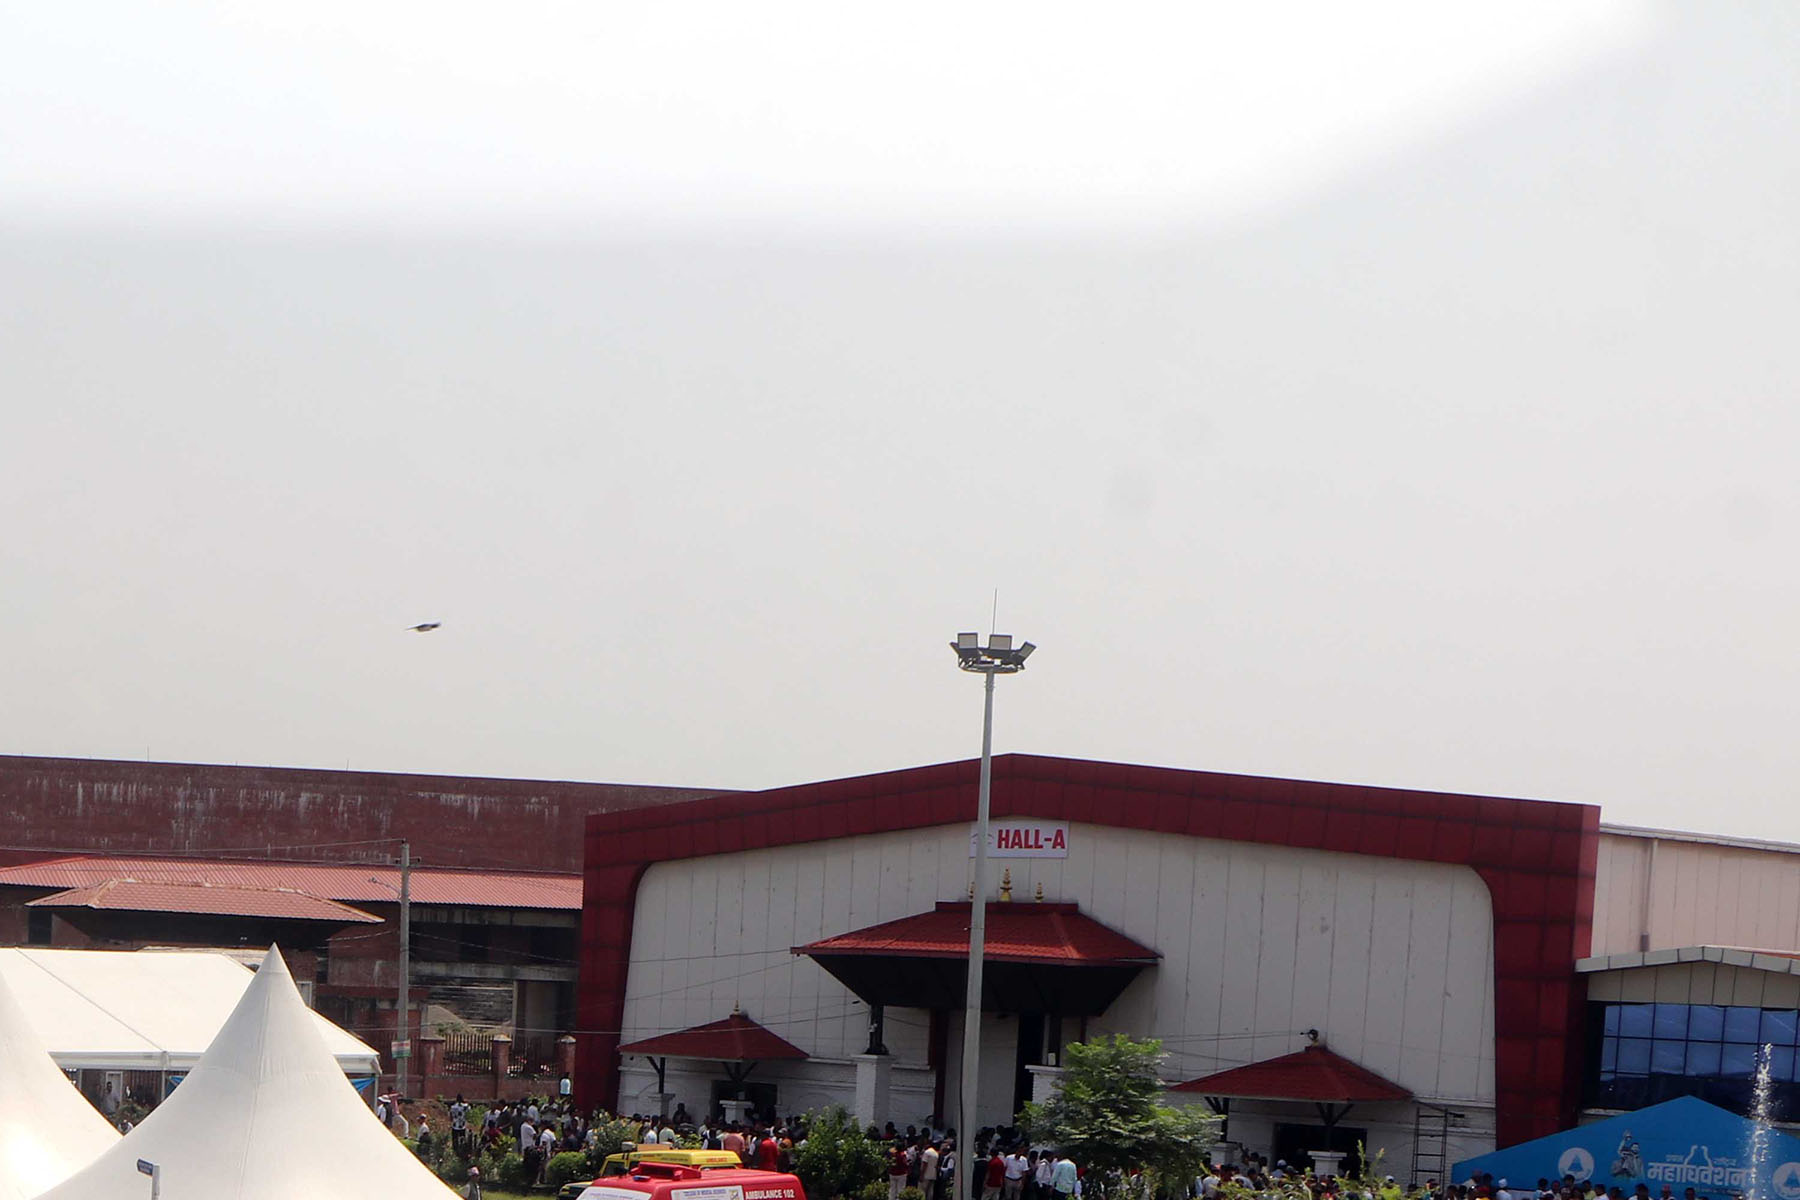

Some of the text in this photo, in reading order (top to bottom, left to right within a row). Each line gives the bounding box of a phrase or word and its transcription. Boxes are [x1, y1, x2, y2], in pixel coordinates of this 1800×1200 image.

[997, 828, 1066, 849] HALL-A
[745, 1189, 795, 1200] AMBULANCE 102
